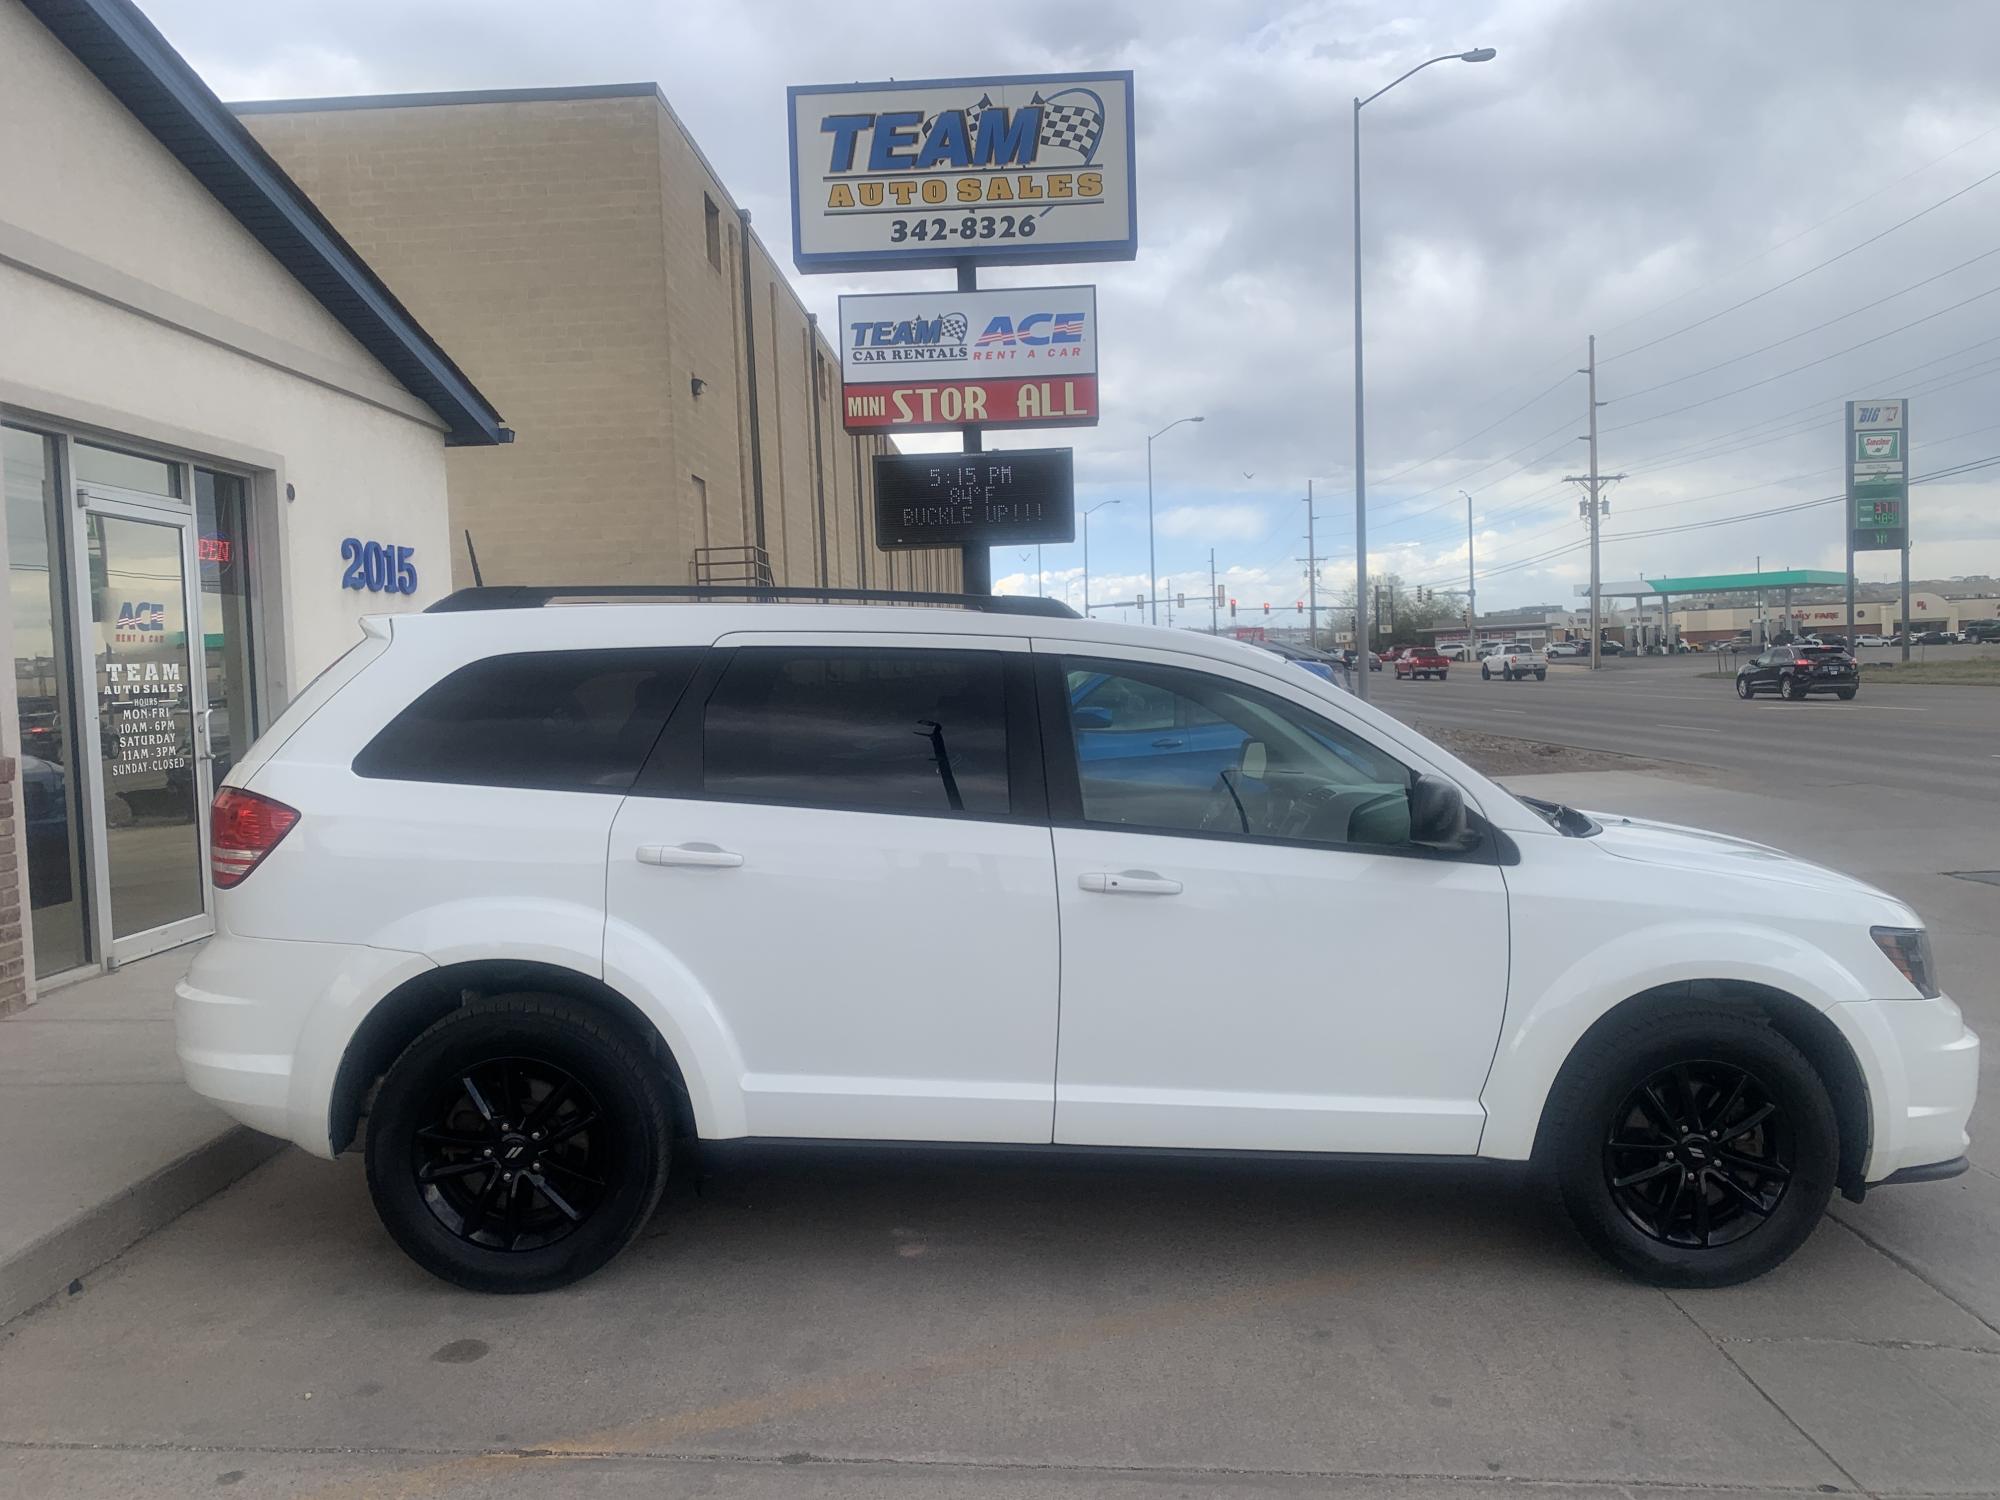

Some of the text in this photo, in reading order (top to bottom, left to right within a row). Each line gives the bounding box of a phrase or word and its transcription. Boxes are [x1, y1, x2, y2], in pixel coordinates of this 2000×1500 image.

[820, 106, 1045, 173] TEAM
[891, 215, 1036, 242] 342-8326
[851, 320, 942, 346] TEAM
[974, 312, 1086, 347] ACE
[852, 347, 968, 361] CAR RENTALS
[973, 347, 1081, 360] RENT A CAR
[848, 382, 1088, 423] MINI STOR ALL
[930, 465, 1012, 487] 5:15 PM
[904, 506, 973, 526] BUCKLE
[198, 538, 232, 561] PEN
[340, 537, 417, 595] 2015
[116, 602, 165, 631] ACE
[105, 663, 180, 681] TEAM
[134, 698, 158, 706] HOURS
[120, 733, 176, 748] SATURDAY
